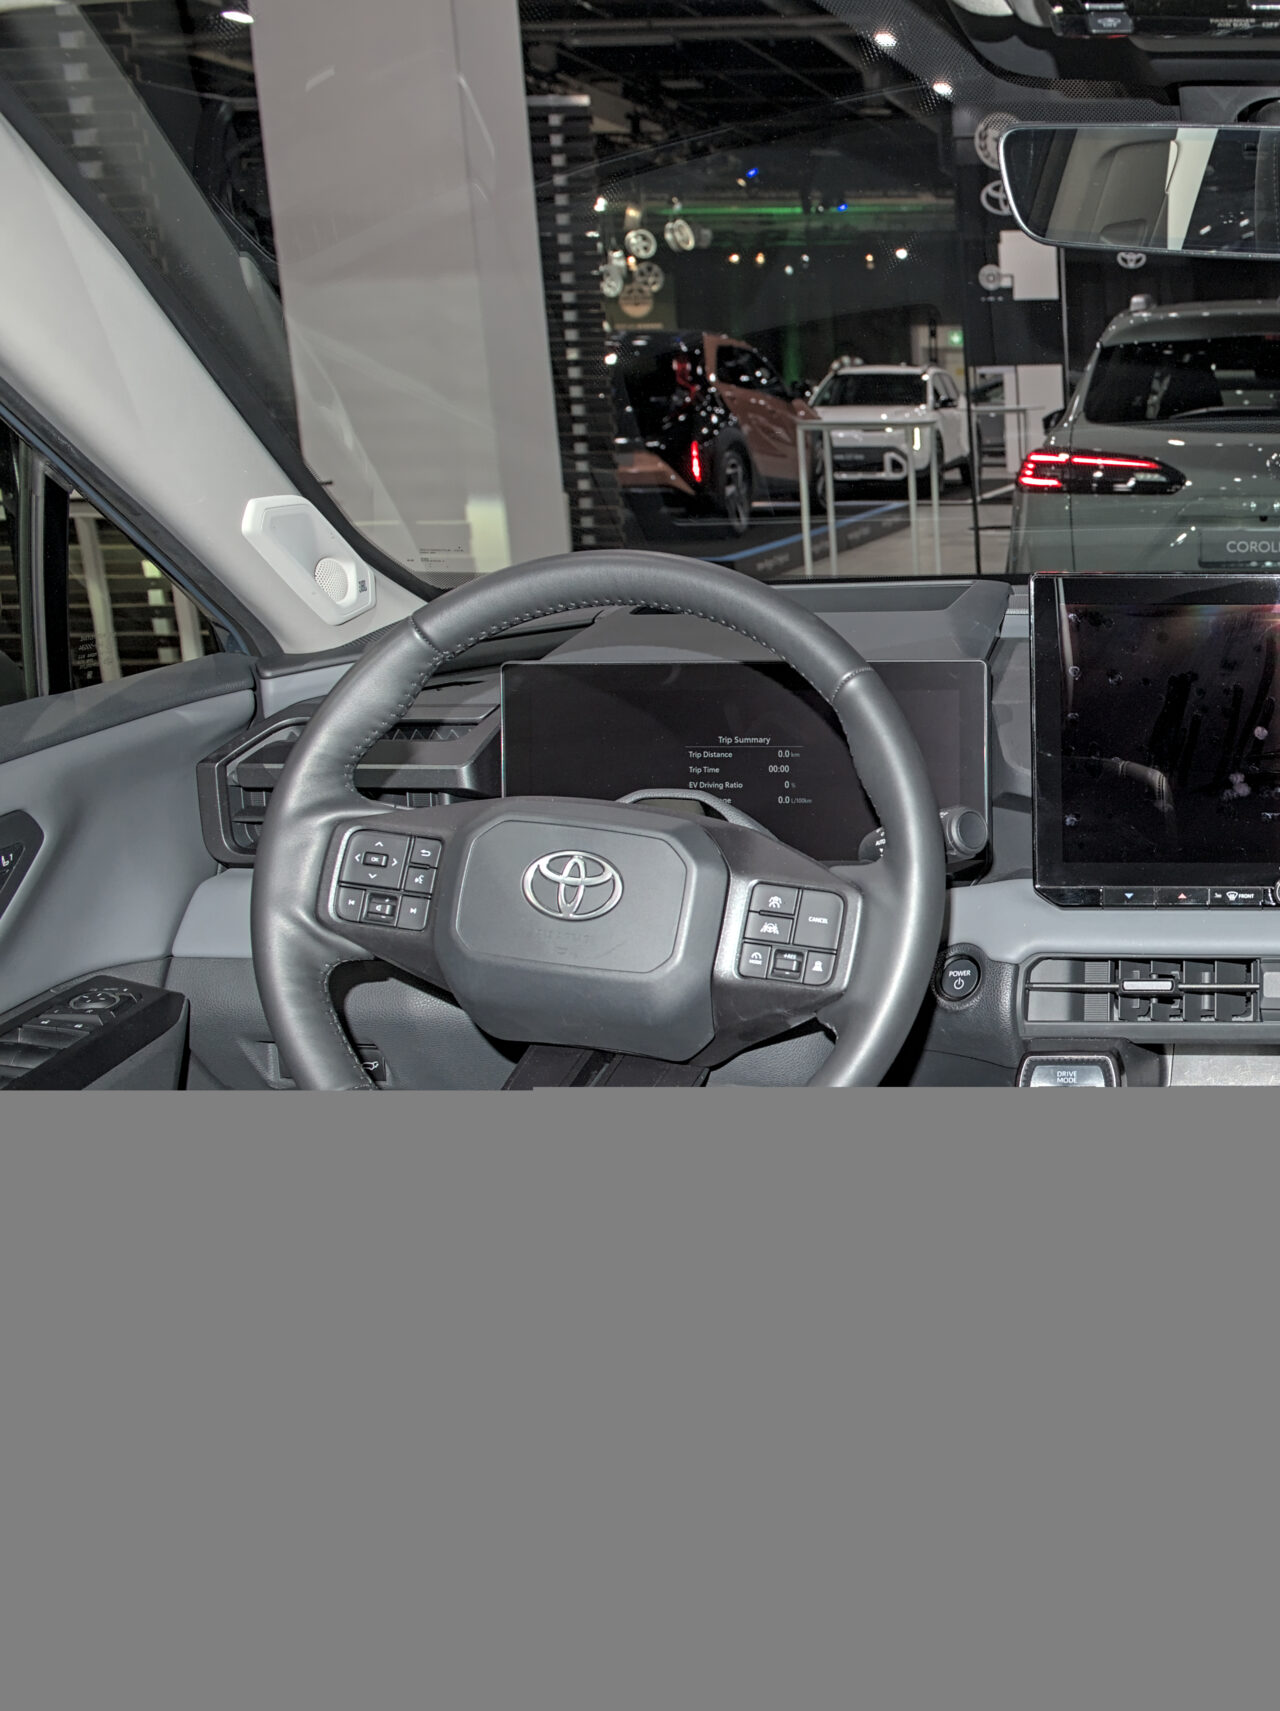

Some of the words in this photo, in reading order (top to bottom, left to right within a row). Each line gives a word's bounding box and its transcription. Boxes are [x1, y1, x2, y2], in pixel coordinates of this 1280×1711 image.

[718, 736, 733, 745] Trip
[734, 736, 771, 745] Summary
[689, 751, 702, 759] Trip
[778, 750, 790, 758] 0.0
[689, 766, 702, 774] Trip
[768, 765, 790, 773] 00:00
[699, 781, 724, 790] Driving
[725, 781, 743, 789] Ratio
[784, 780, 790, 789] 0
[778, 796, 790, 804] 0.0
[808, 916, 828, 925] CANCEL
